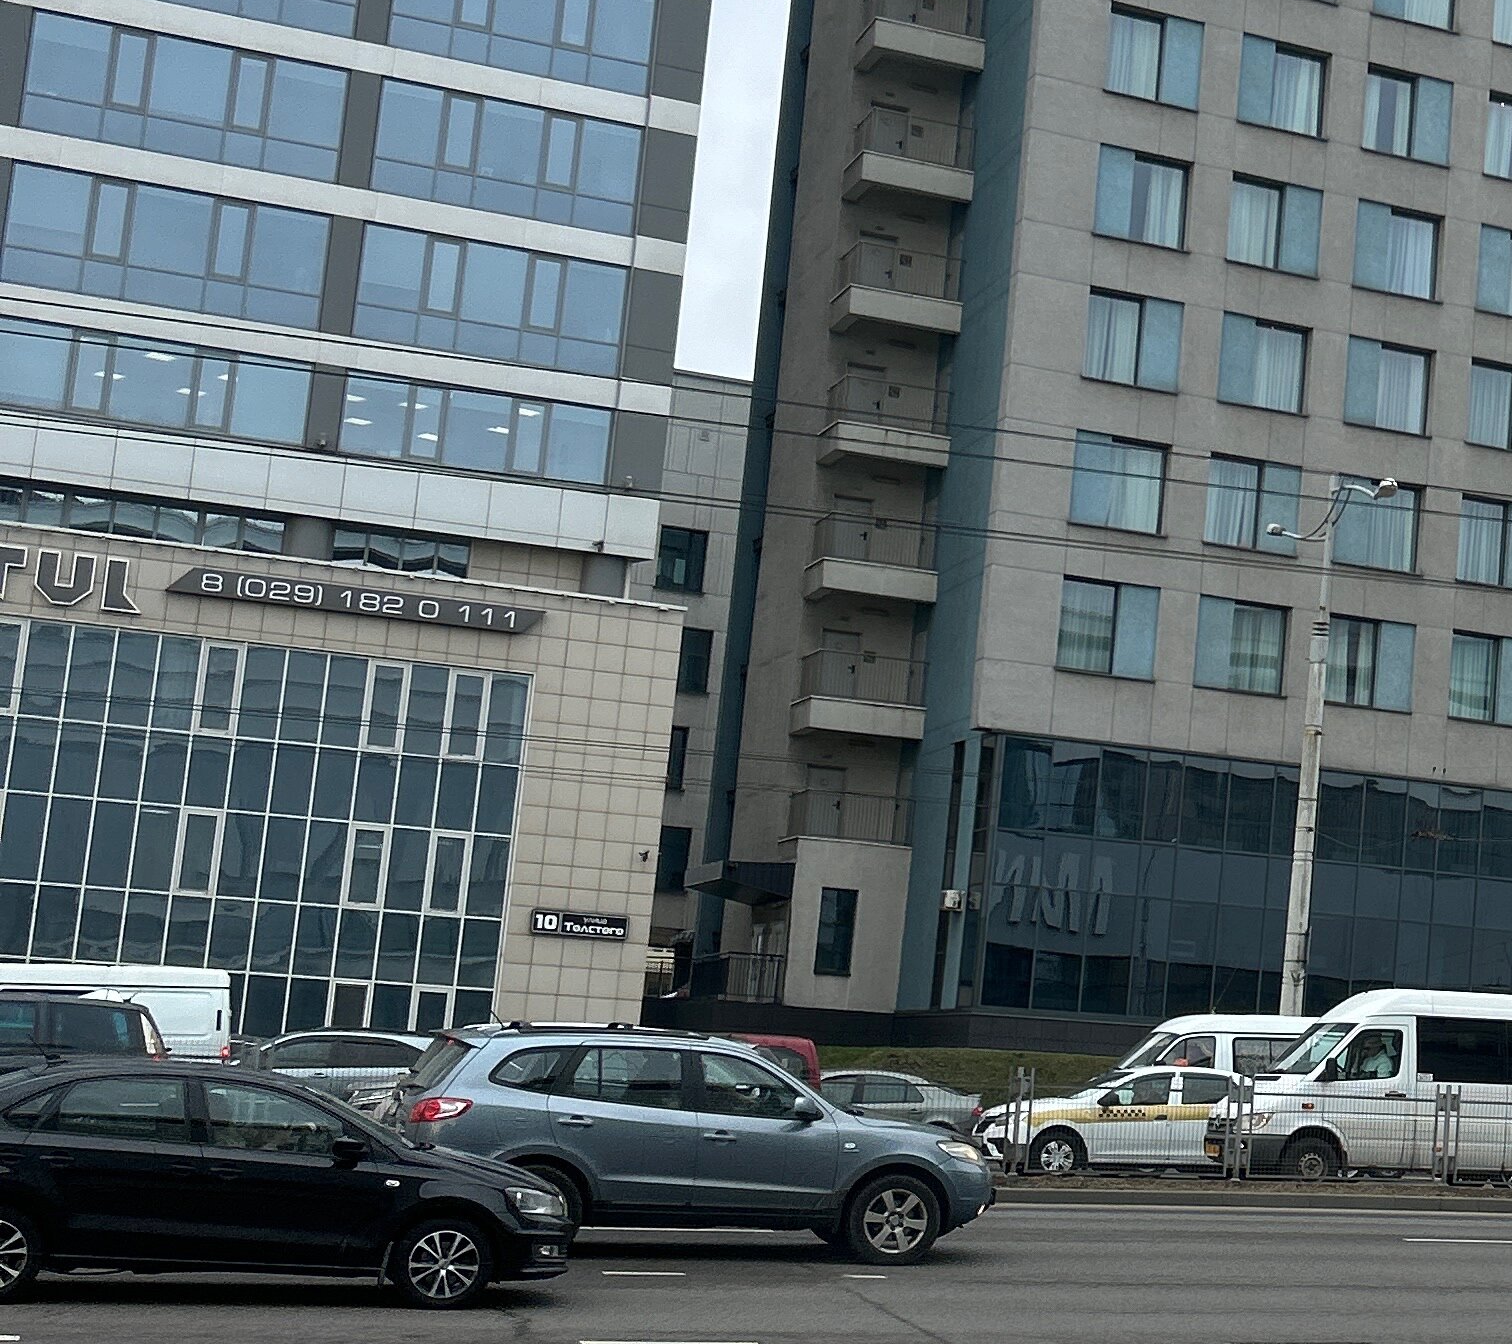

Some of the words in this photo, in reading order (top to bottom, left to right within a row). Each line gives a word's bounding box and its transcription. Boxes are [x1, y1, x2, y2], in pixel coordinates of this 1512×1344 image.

[201, 573, 223, 592] 8
[237, 576, 323, 606] (029)
[340, 590, 404, 615] 182
[418, 600, 440, 618] 0
[458, 605, 518, 629] 111
[535, 914, 558, 930] 10
[563, 921, 624, 936] Толстого
